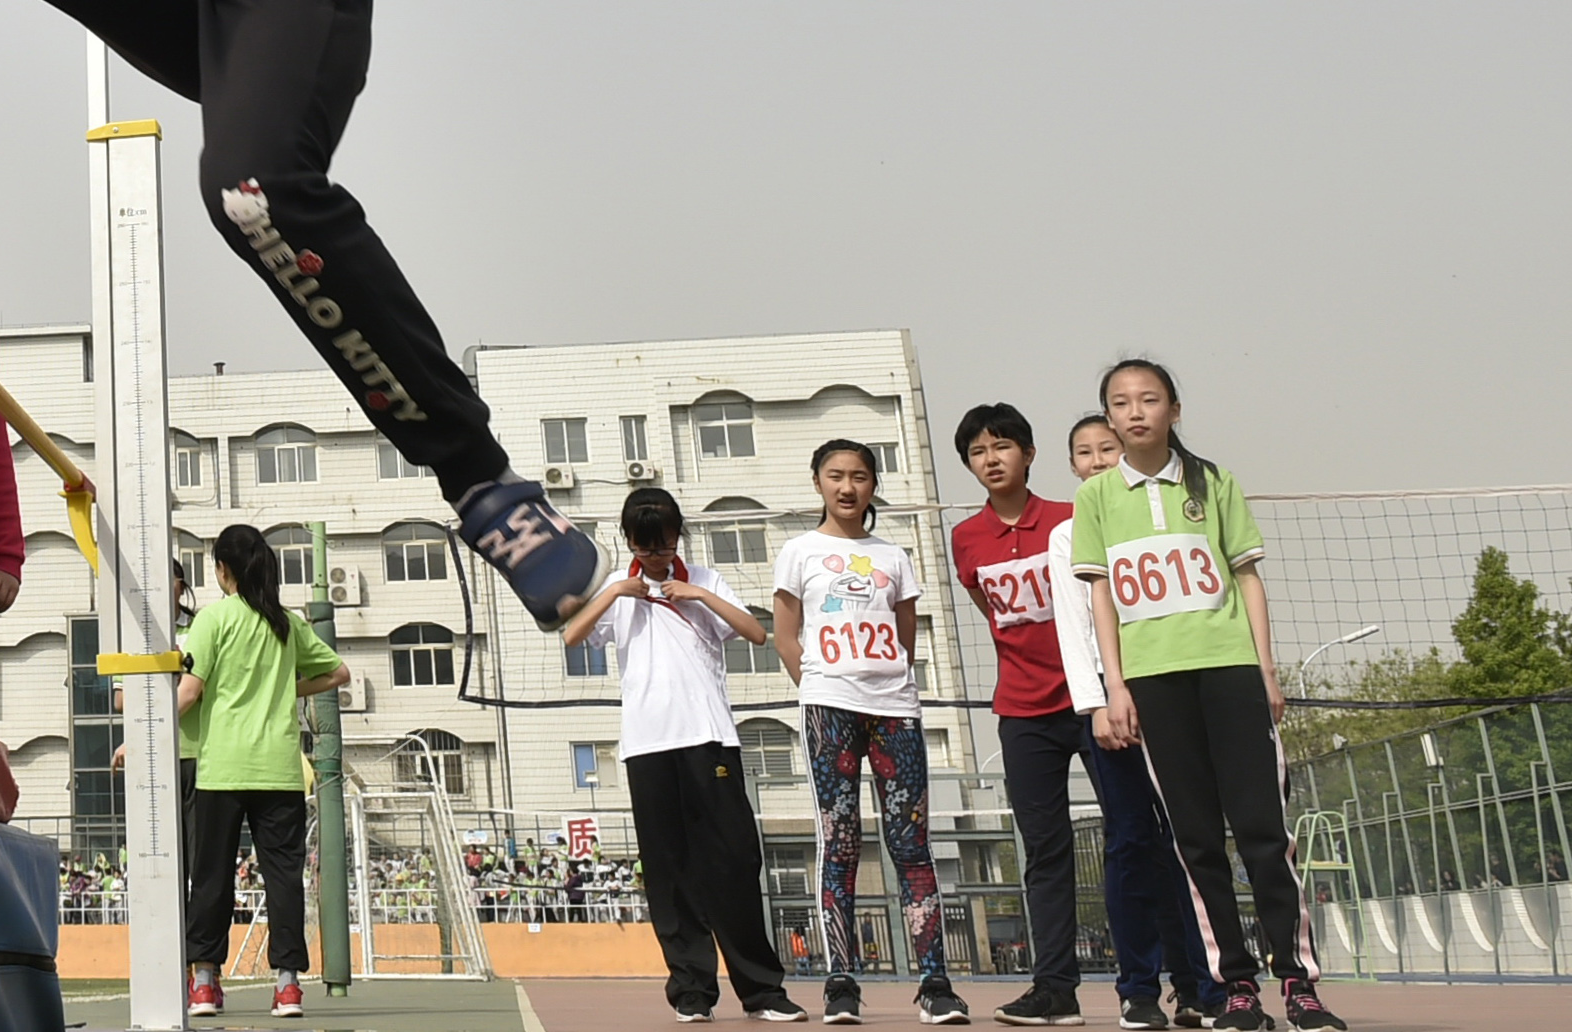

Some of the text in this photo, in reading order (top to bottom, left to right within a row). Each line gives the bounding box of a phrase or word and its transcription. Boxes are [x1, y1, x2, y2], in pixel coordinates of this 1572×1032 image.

[238, 216, 428, 421] HELLO KITTY
[1112, 547, 1220, 607] 6613
[819, 621, 898, 664] 6123
[567, 817, 598, 859] 质
